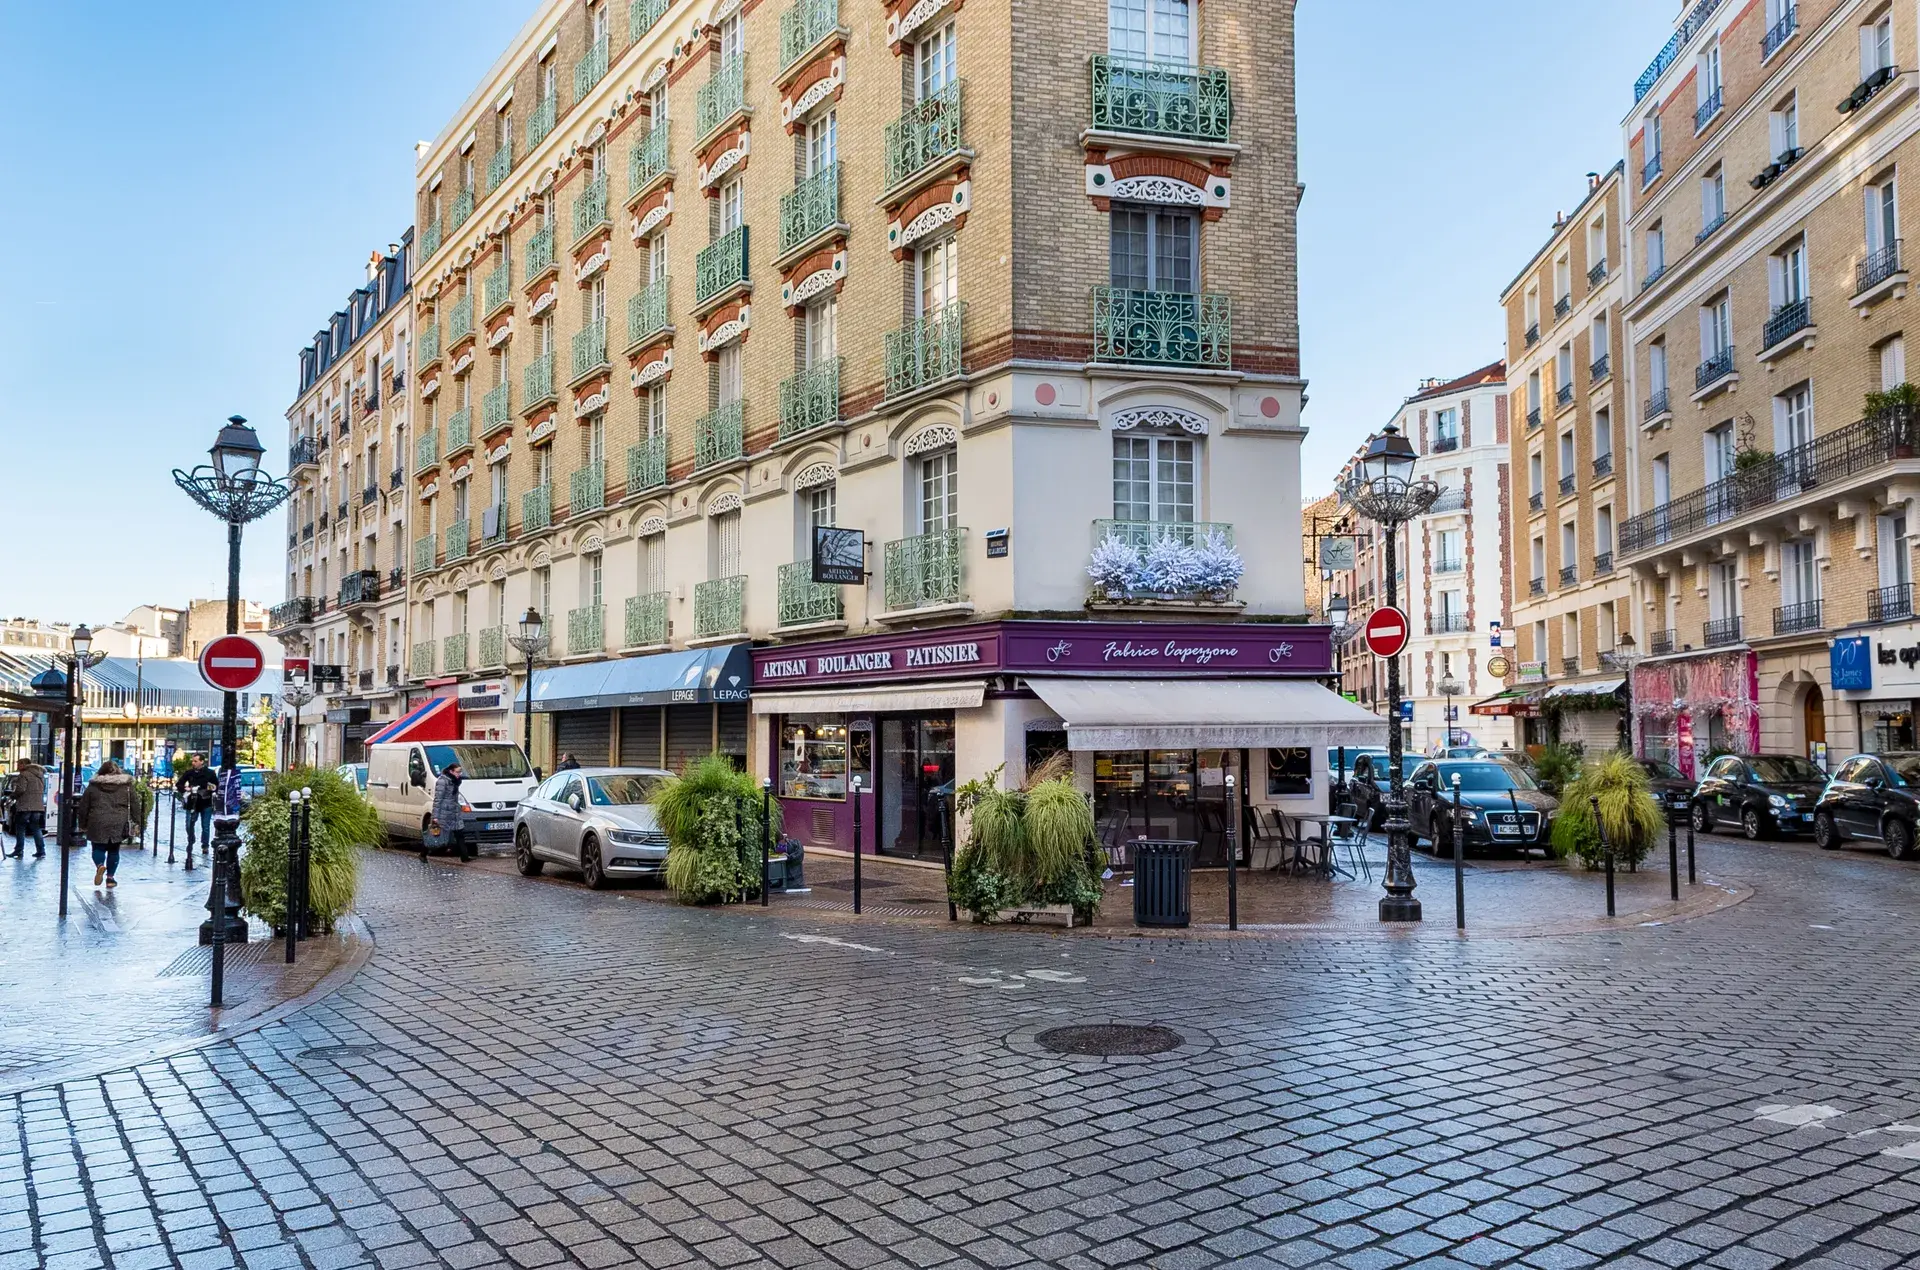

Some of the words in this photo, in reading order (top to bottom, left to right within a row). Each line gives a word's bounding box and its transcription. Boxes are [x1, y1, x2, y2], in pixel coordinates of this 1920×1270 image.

[822, 573, 859, 581] BOULANGER
[1102, 641, 1159, 661] Fabrice
[1163, 640, 1238, 664] Capezzone
[1877, 642, 1897, 665] les
[762, 659, 807, 678] ARTISAN
[817, 651, 892, 674] BOULANGER
[906, 642, 980, 666] PATISSIER
[1840, 668, 1863, 681] James
[672, 690, 694, 701] LEPAGE
[713, 689, 750, 700] LEPAG
[144, 705, 172, 717] GARE
[175, 705, 189, 717] DE
[531, 701, 544, 710] EPAGE
